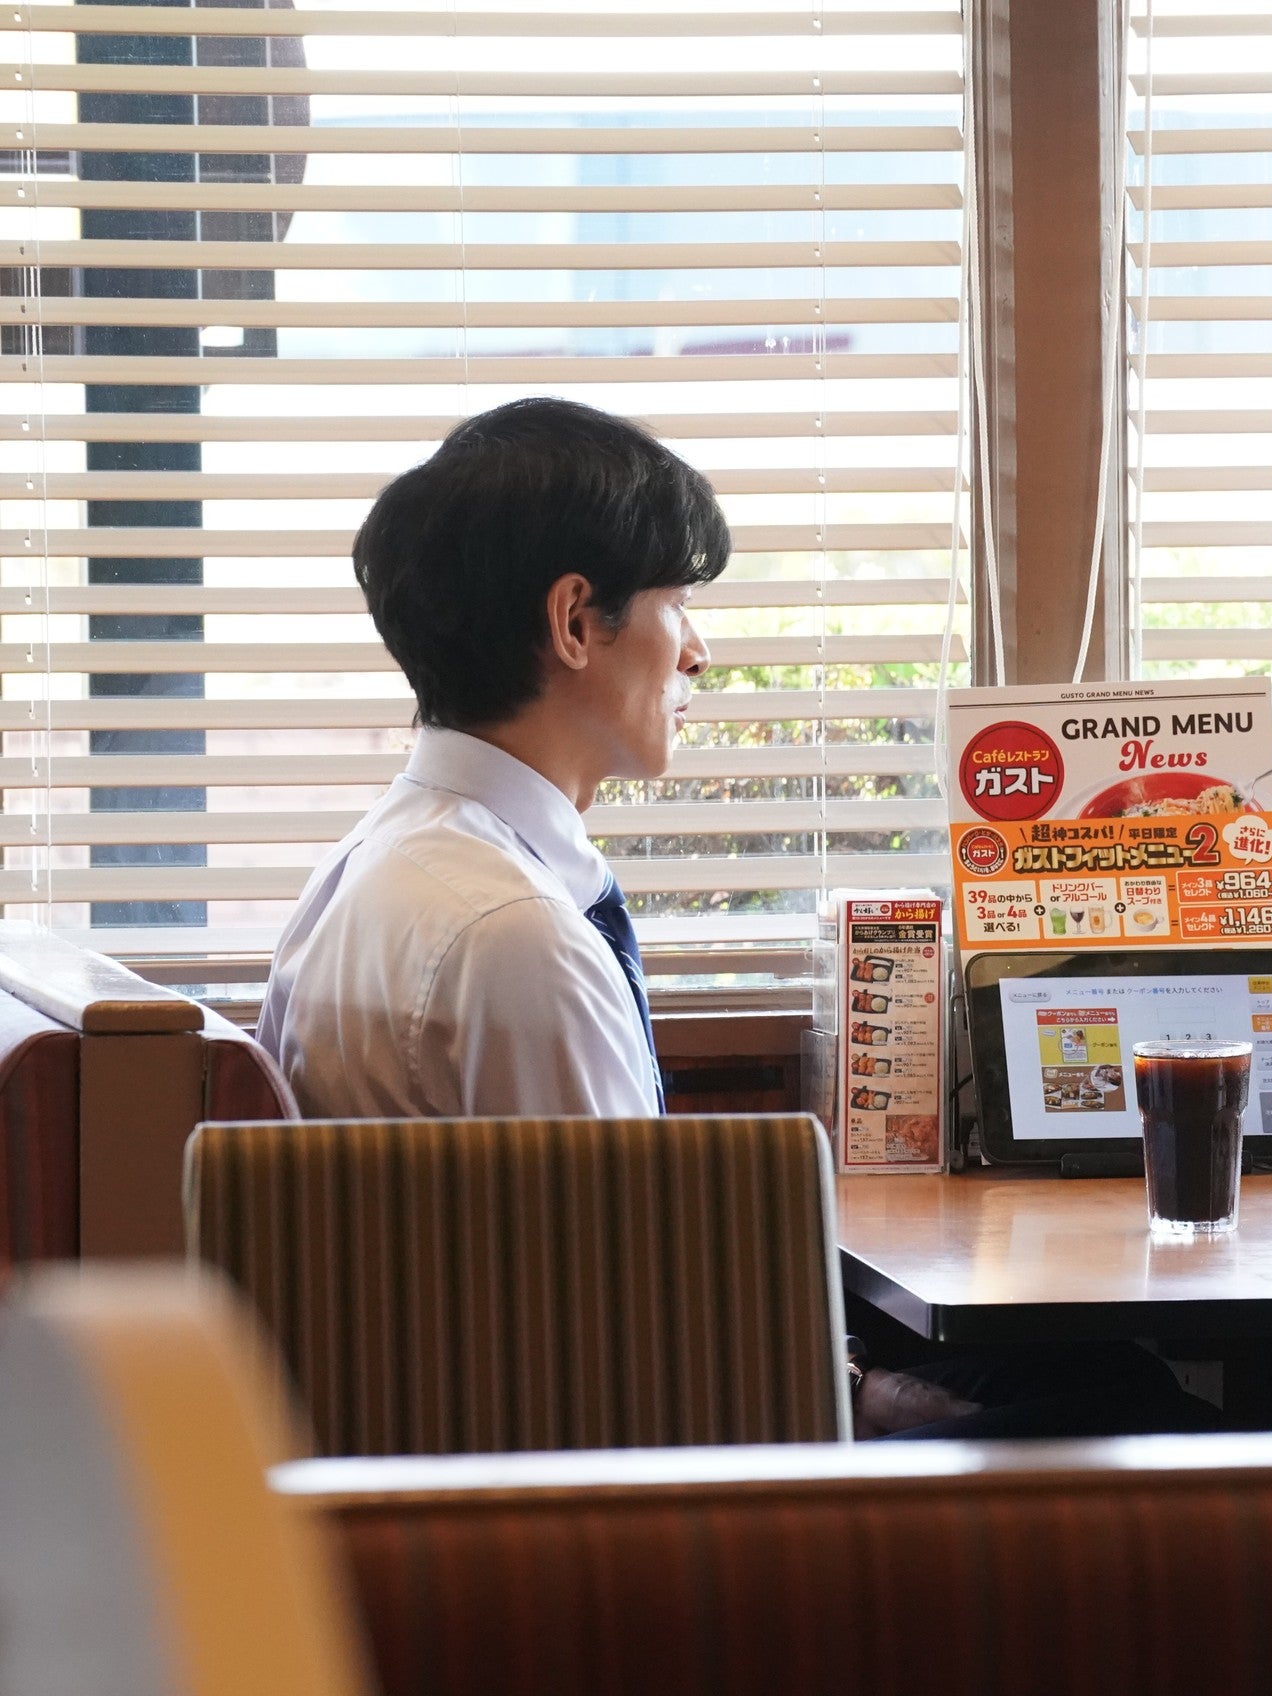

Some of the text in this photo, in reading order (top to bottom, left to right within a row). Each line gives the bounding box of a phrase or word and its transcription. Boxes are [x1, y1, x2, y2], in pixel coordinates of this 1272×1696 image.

[1061, 711, 1254, 740] GRAND MENU
[1118, 739, 1208, 772] News
[975, 766, 1054, 797] ガスト
[1031, 823, 1178, 842] 超神コスパ! 平日限定
[1239, 825, 1266, 837] さらに
[1234, 836, 1271, 855] 進化!
[972, 849, 996, 858] ガスト
[1051, 882, 1104, 893] ドリンクバー
[1126, 887, 1161, 896] 日替わり
[1183, 888, 1212, 897] セレクト
[967, 890, 1033, 904] 39品の中から
[1050, 893, 1108, 903] or アルコール
[1127, 897, 1163, 906] スープ付き
[894, 908, 936, 919] から揚げ
[976, 905, 1028, 919] 3品 or 4品
[983, 921, 1021, 933] 選べる!
[1186, 923, 1215, 932] セレクト
[1106, 987, 1125, 995] または
